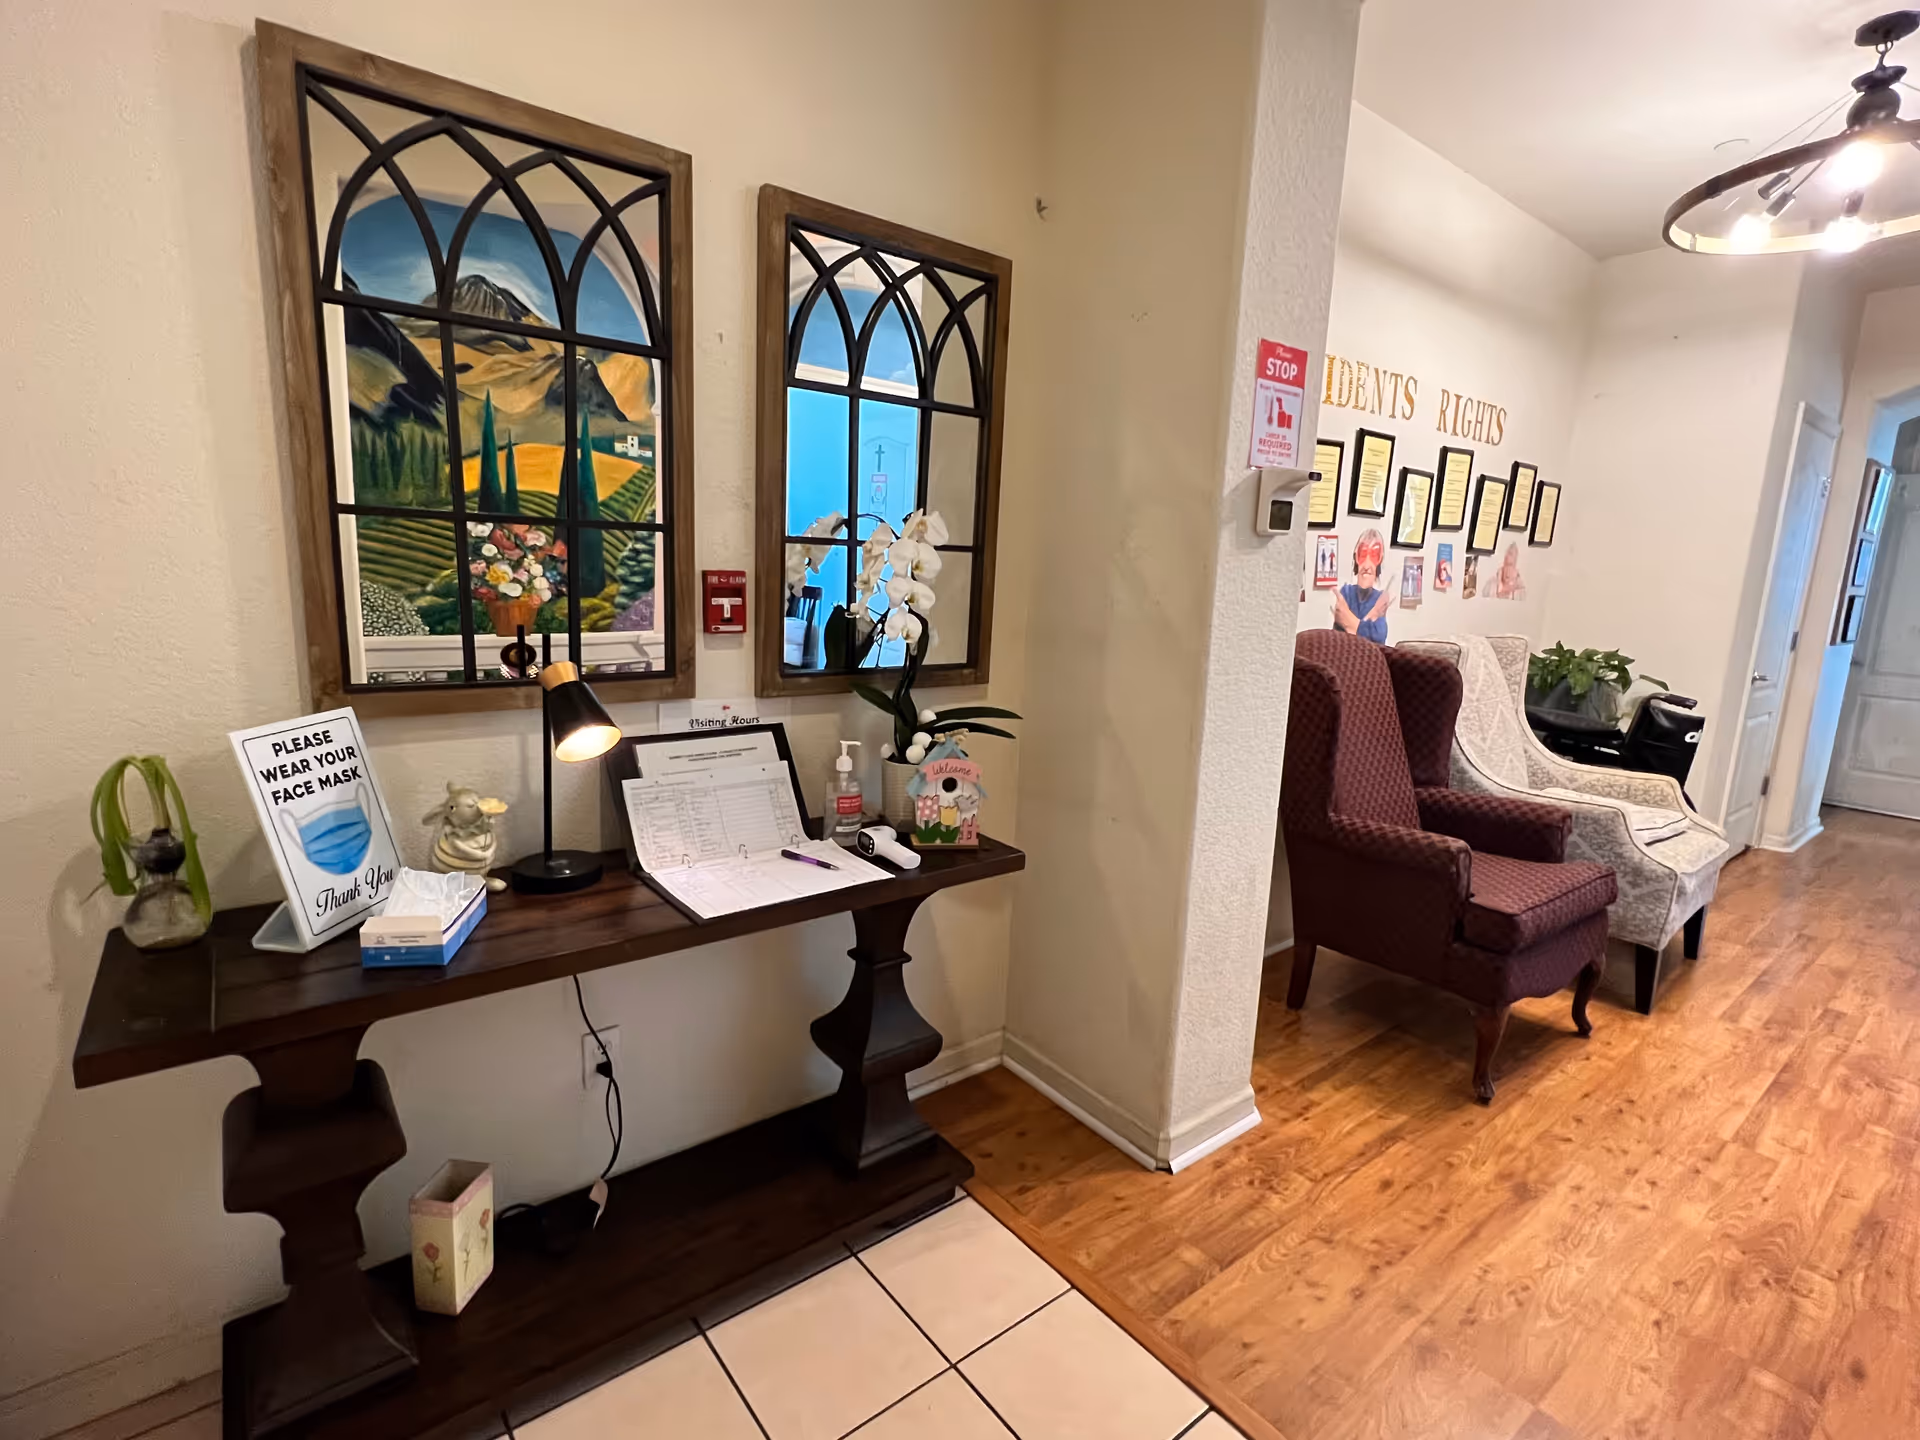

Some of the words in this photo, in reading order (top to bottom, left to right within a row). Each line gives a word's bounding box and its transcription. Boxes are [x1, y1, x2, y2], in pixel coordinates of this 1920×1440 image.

[1266, 357, 1298, 380] STOP
[1436, 388, 1507, 446] RIGHTS
[1258, 438, 1292, 451] REQUIRED
[688, 717, 727, 728] Visiting
[729, 716, 760, 726] Hours
[271, 730, 333, 757] PLEASE
[259, 758, 312, 784] WEAR
[313, 745, 358, 770] YOUR
[932, 762, 972, 776] Welcome
[270, 779, 315, 806] FACE
[318, 765, 363, 791] MASK
[316, 877, 361, 917] Thank
[364, 864, 395, 900] You
